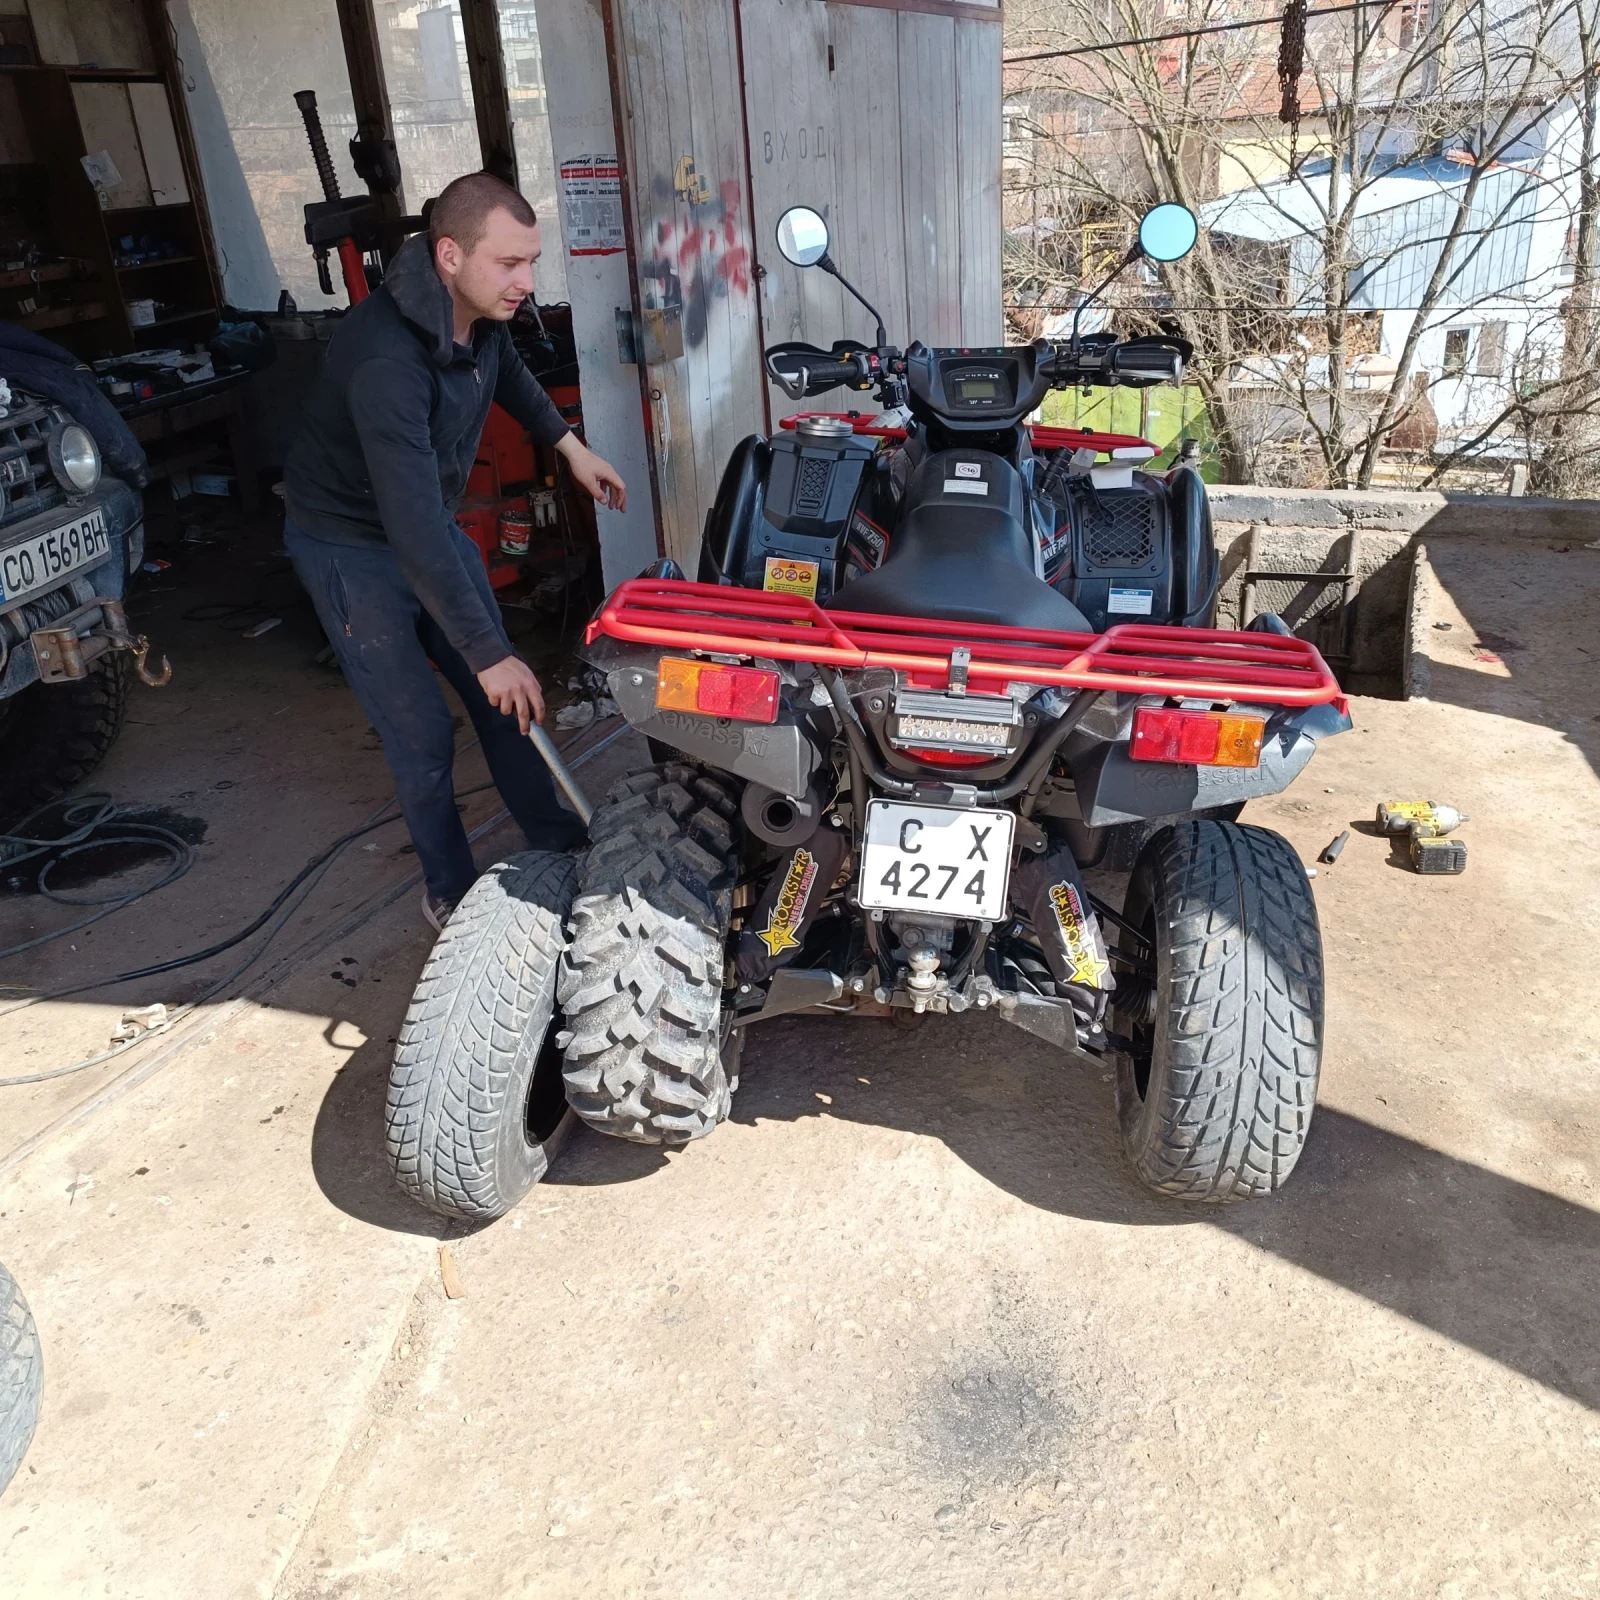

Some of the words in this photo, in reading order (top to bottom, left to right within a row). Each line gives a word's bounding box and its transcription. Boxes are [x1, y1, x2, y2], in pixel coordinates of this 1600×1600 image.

[763, 126, 827, 164] ВХОД
[3, 549, 35, 592] CO
[38, 528, 80, 577] 1569
[80, 515, 106, 556] BH
[899, 818, 924, 854] C
[966, 824, 992, 862] X
[787, 892, 805, 926] ENERGY
[800, 863, 815, 891] DRINK
[880, 860, 985, 905] 4274
[1067, 888, 1080, 915] DRINK
